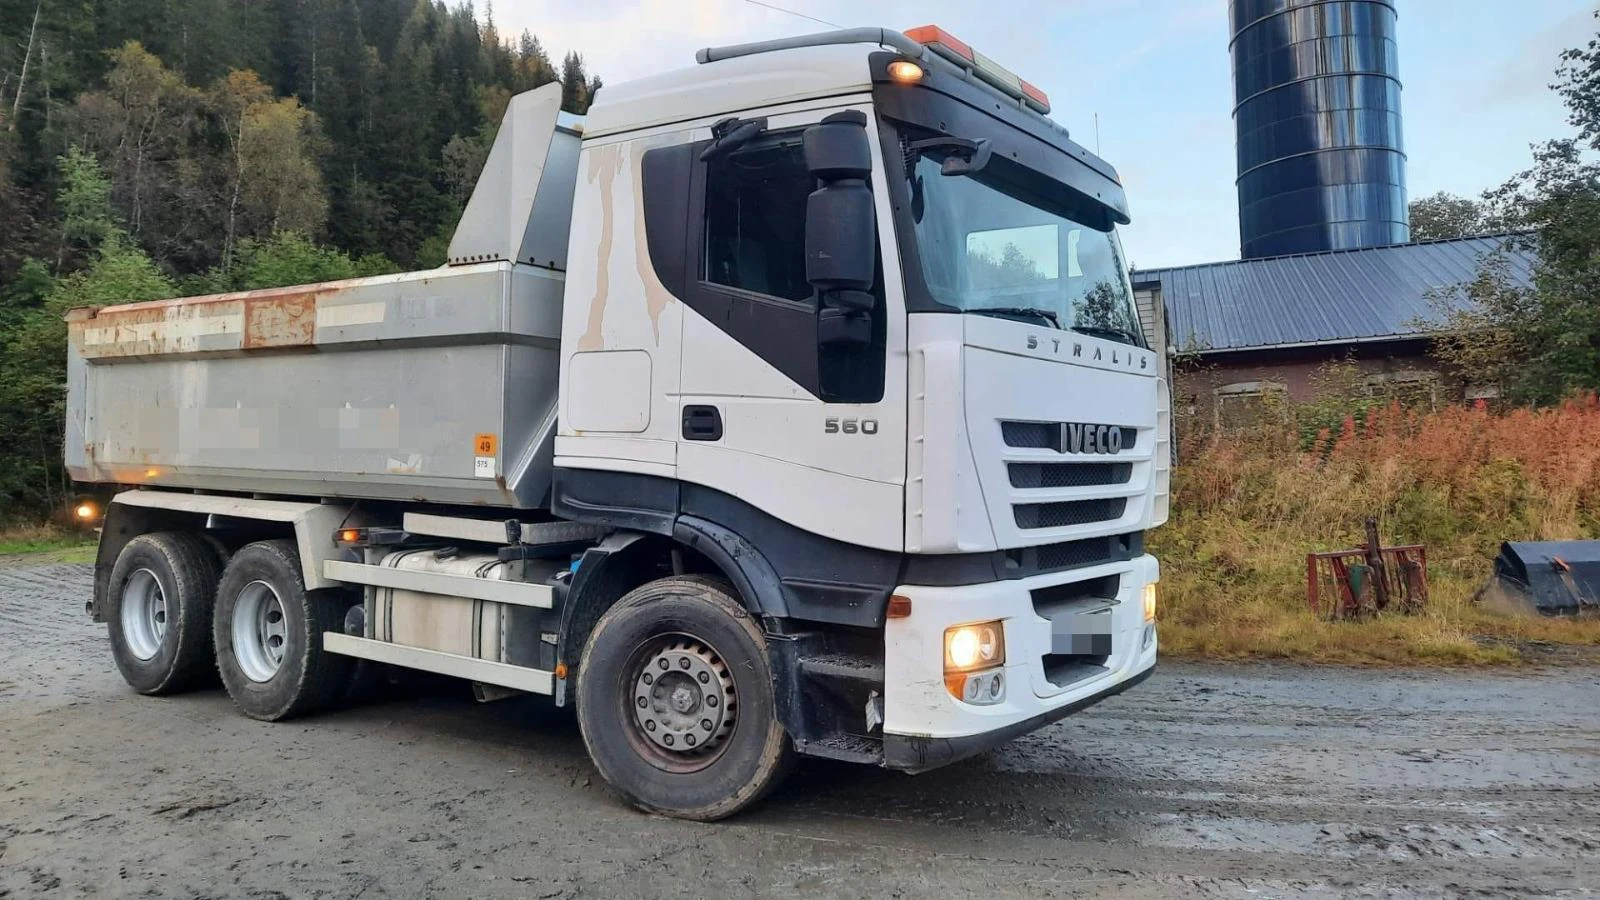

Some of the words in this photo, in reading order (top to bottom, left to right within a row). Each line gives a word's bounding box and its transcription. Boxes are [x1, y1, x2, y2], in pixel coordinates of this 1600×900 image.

[1027, 336, 1147, 369] STRALIS
[825, 418, 878, 434] 560
[1060, 422, 1122, 454] IVECO
[480, 441, 491, 452] 49
